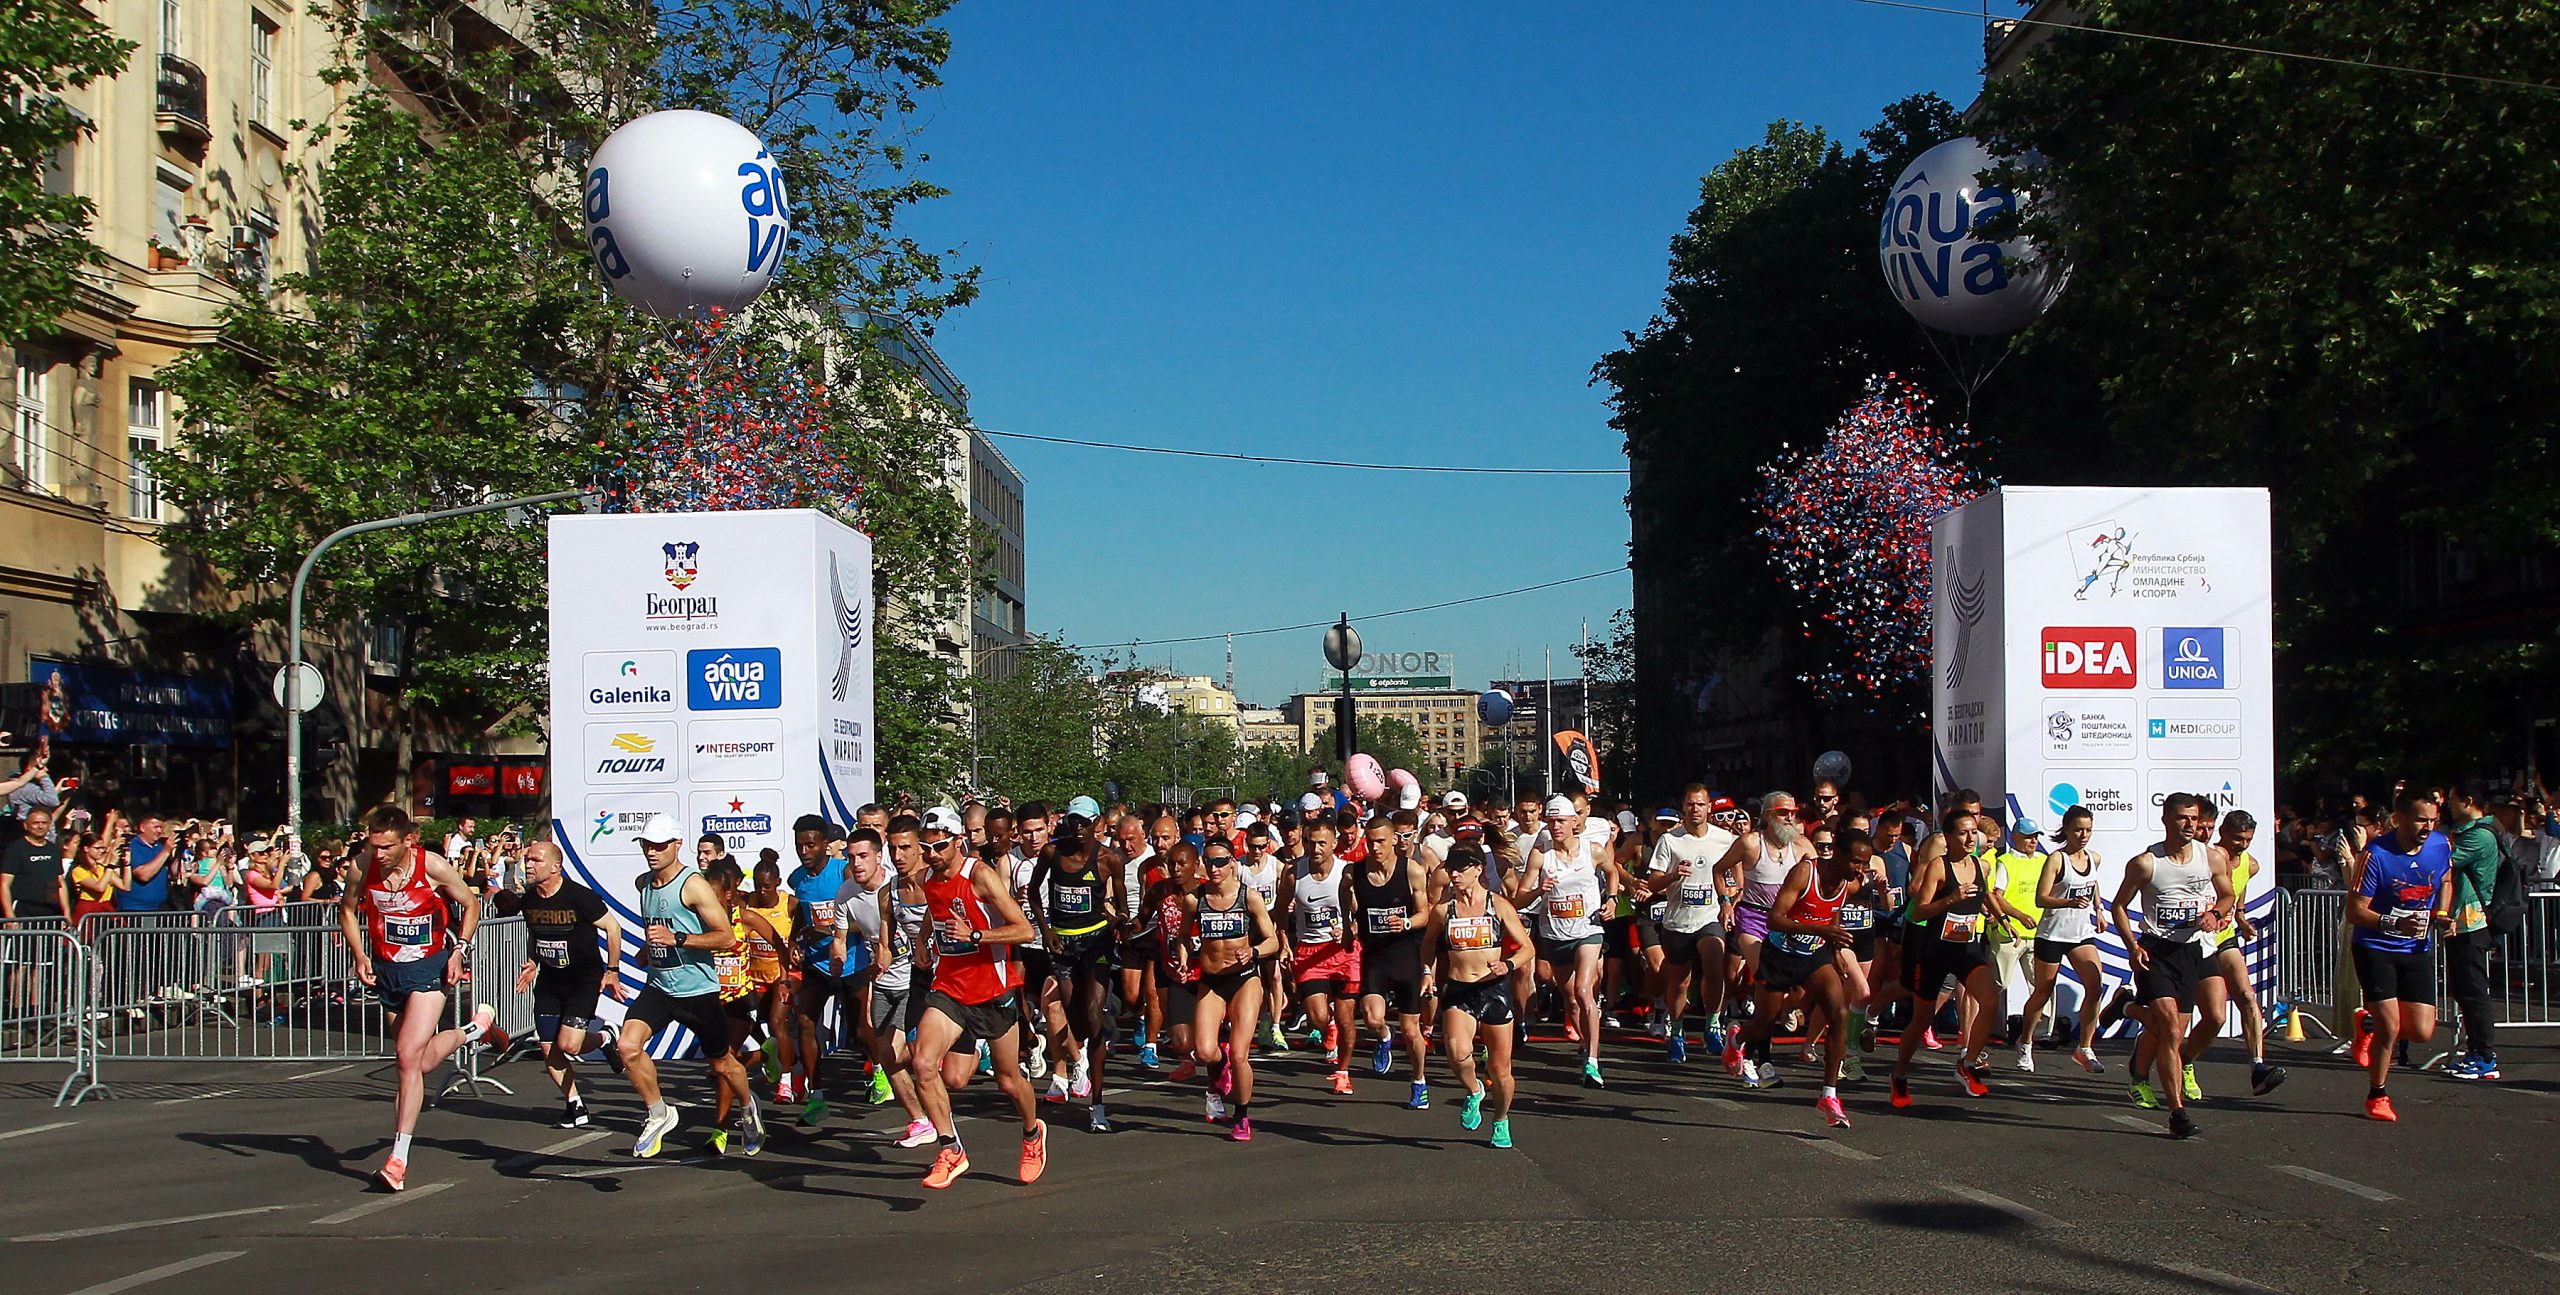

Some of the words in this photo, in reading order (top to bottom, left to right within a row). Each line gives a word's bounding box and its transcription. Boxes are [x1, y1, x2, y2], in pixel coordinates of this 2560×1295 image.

[2132, 554, 2175, 563] Република
[2177, 554, 2205, 563] Србија
[2132, 566, 2206, 575] МИНИСТАРСТВО
[2132, 577, 2185, 587] ОМЛАДИНЕ
[2141, 589, 2177, 598] СПОРТА
[646, 592, 719, 621] Београд
[646, 622, 719, 632] www.beograd.rs
[2045, 641, 2132, 675] iDEA
[704, 660, 764, 683] aqua
[2168, 665, 2218, 680] UNIQA
[590, 685, 671, 704] Galenika
[710, 680, 760, 702] viva
[2081, 713, 2105, 721] БАНКА
[2081, 722, 2127, 730] ПОШТАНСКА
[2170, 724, 2236, 734] MEDIGROUP
[1948, 722, 1984, 746] МАРАТОН
[2081, 732, 2133, 740] ШТЕДИОНИЦА
[706, 743, 774, 754] INTERSPORT
[834, 739, 862, 763] МАРАТОН
[597, 758, 666, 773] ПОШТА
[2085, 789, 2120, 801] bright
[2086, 801, 2133, 811] marbles
[706, 817, 769, 833] Heineken
[1060, 894, 1082, 904] 6959
[1843, 912, 1862, 920] 3132
[2160, 909, 2186, 920] 2545
[1211, 920, 1234, 930] 6873
[397, 926, 420, 936] 6161
[1454, 928, 1478, 938] 0167
